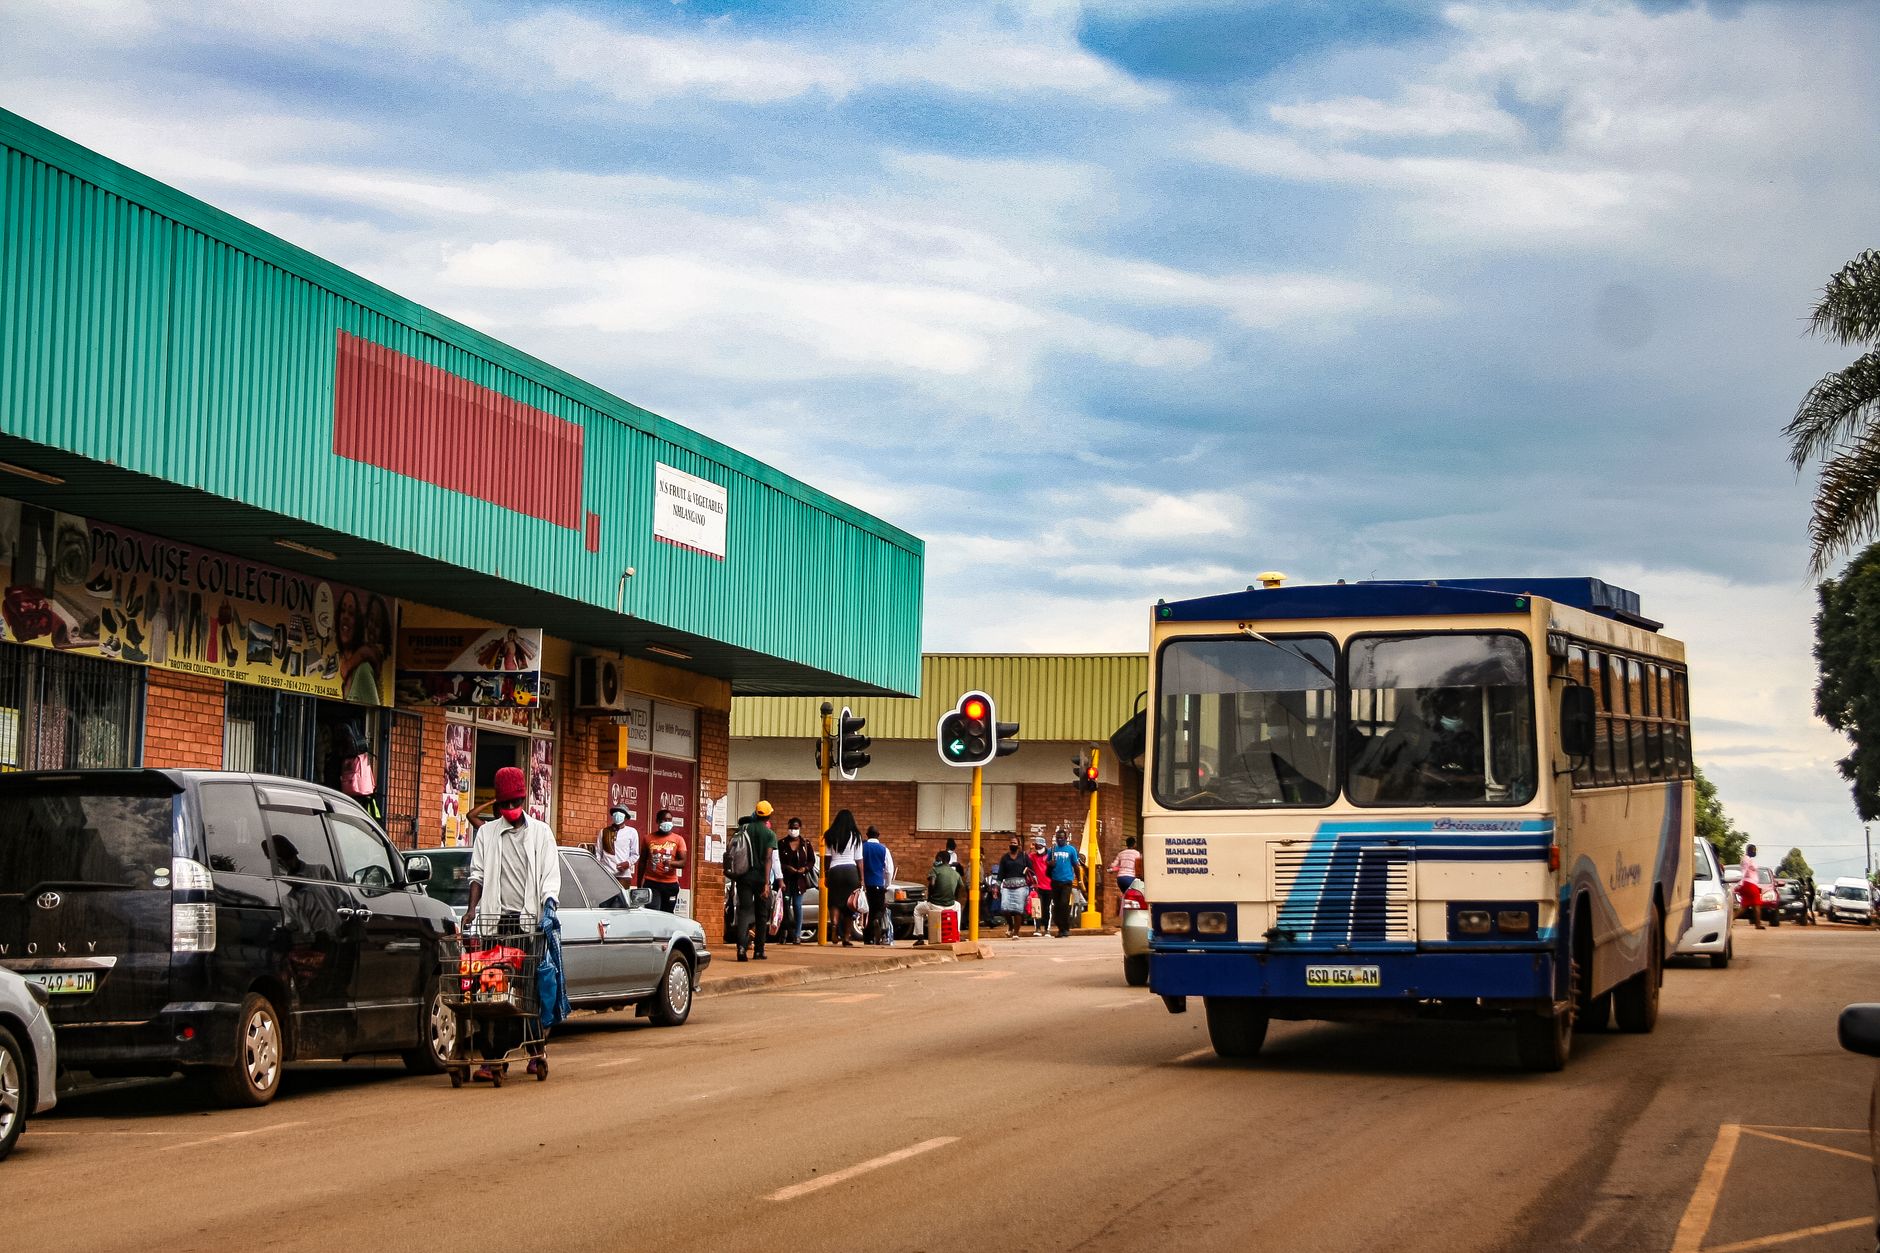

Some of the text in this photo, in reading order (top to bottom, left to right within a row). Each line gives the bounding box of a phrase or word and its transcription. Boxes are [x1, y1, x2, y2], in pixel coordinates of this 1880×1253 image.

[669, 484, 686, 500] FRUIT
[687, 490, 692, 503] &
[692, 492, 724, 515] VEGETABLES
[91, 527, 314, 613] PROMISE COLLECTION
[408, 635, 464, 647] PROMISE
[168, 658, 250, 680] "BROTHER COLLECTION IS THE BEST"
[655, 721, 665, 733] Live
[665, 722, 674, 734] With
[620, 785, 638, 800] UNITED
[668, 793, 685, 807] UNITED
[1165, 848, 1207, 856] MAHLALINI
[1166, 857, 1208, 865] NHLANGANO
[1167, 867, 1209, 875] INTERBOARD
[0, 941, 96, 954] VOXY
[77, 974, 93, 990] DM
[1332, 969, 1354, 983] 054
